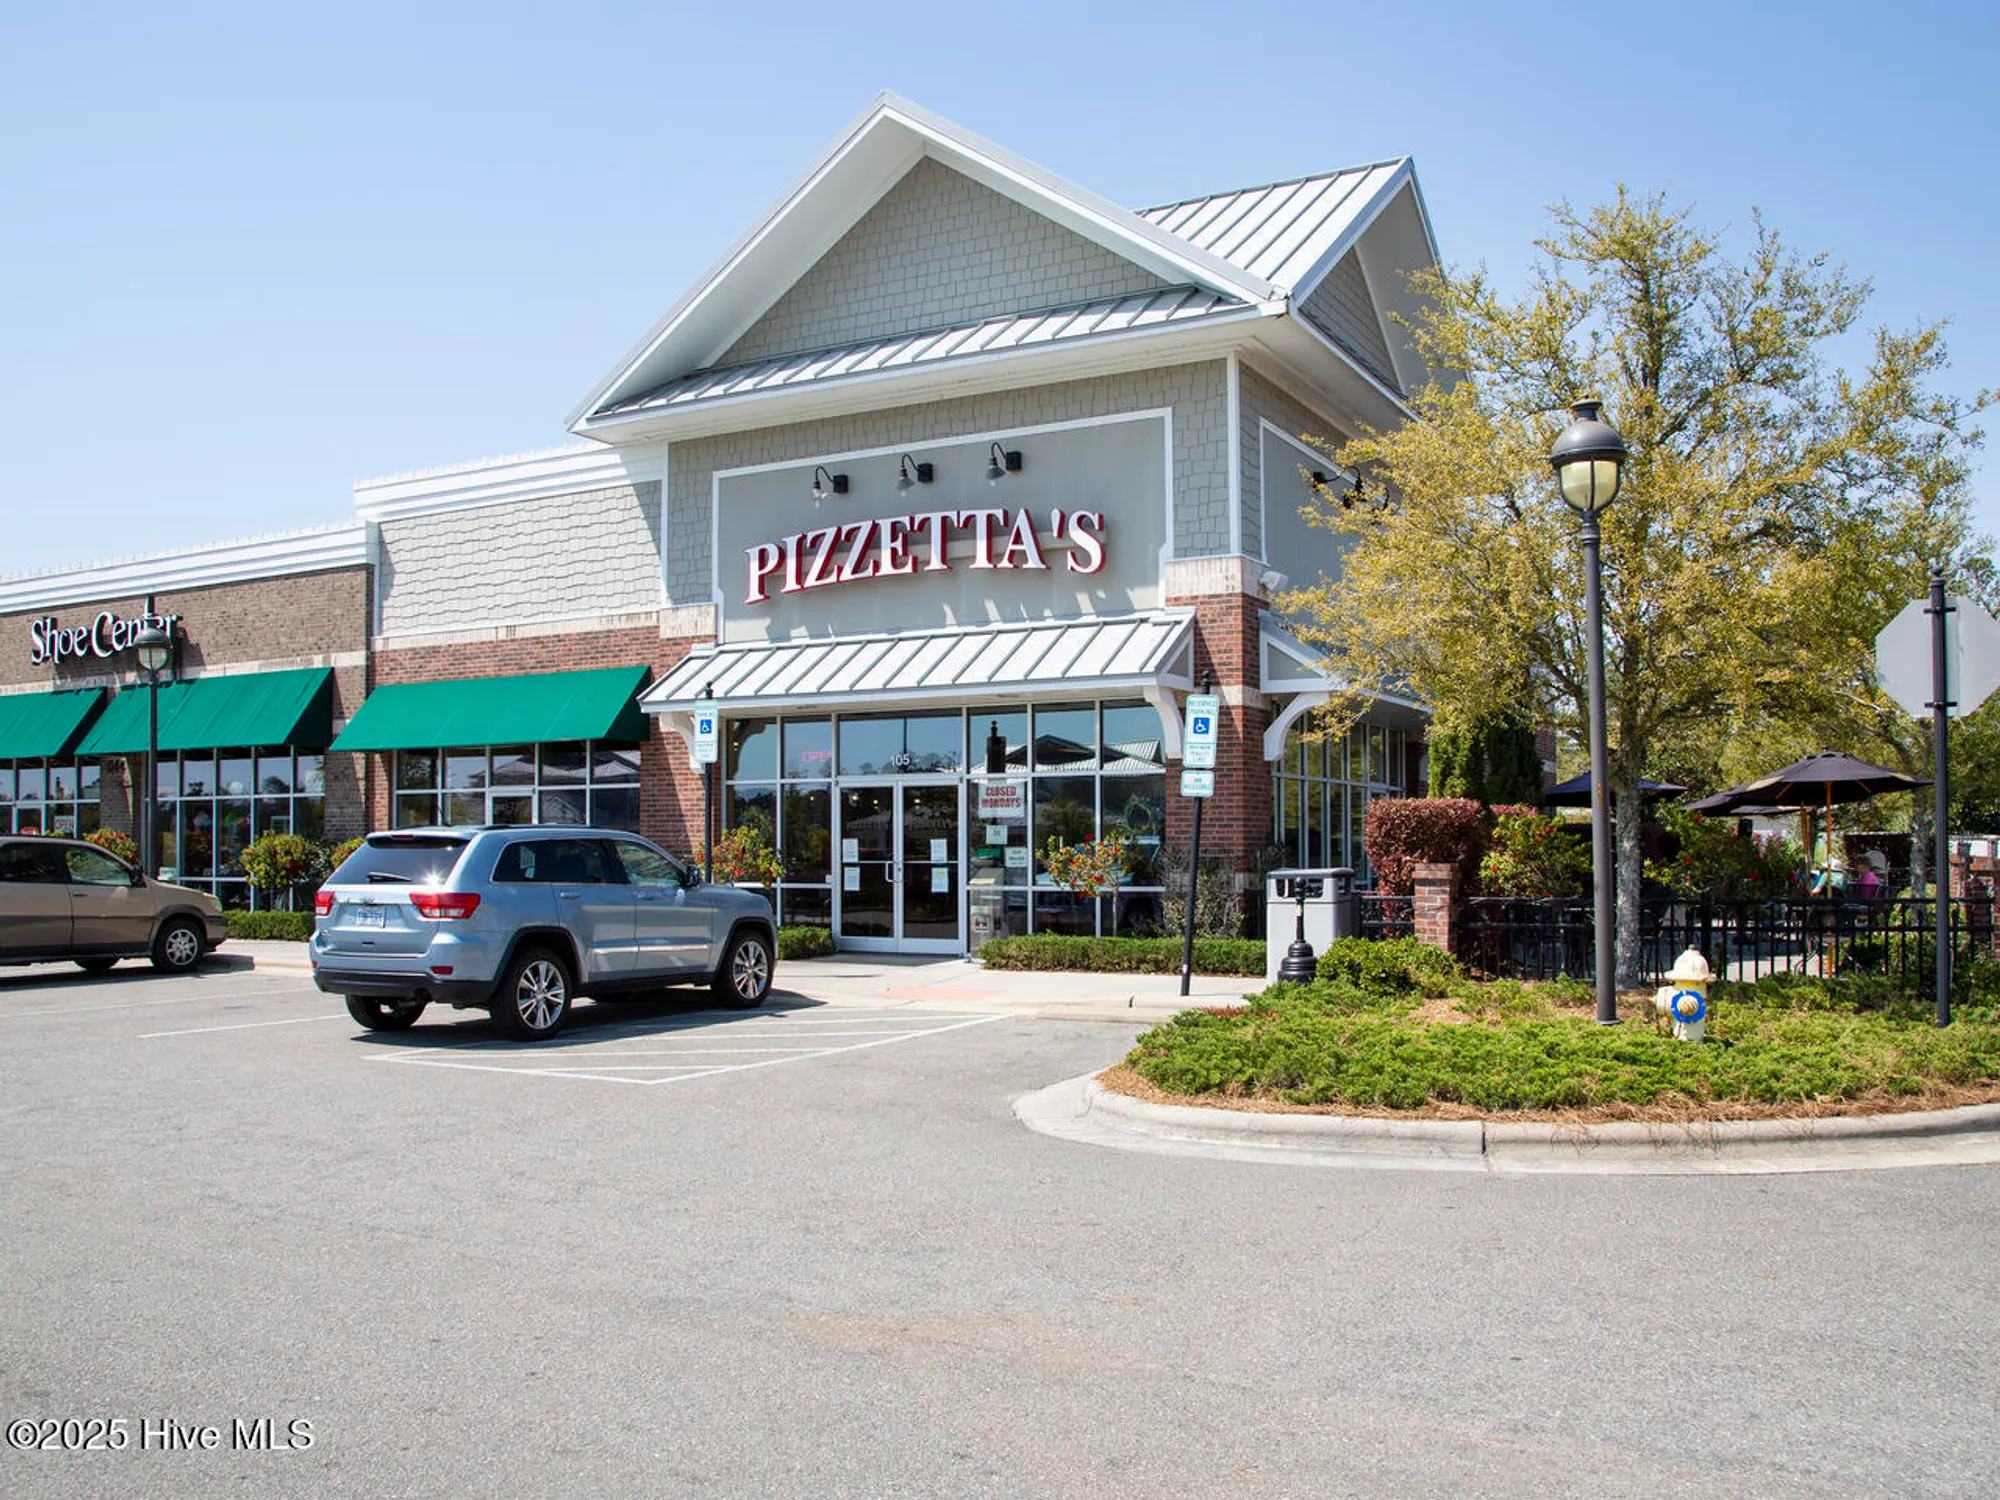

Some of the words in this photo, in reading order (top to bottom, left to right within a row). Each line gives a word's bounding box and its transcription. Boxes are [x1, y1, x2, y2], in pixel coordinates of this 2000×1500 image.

[744, 507, 1107, 604] PIZZETTA'S
[31, 617, 88, 664] Shoe
[890, 753, 910, 766] 105
[985, 786, 1017, 797] CLOSED
